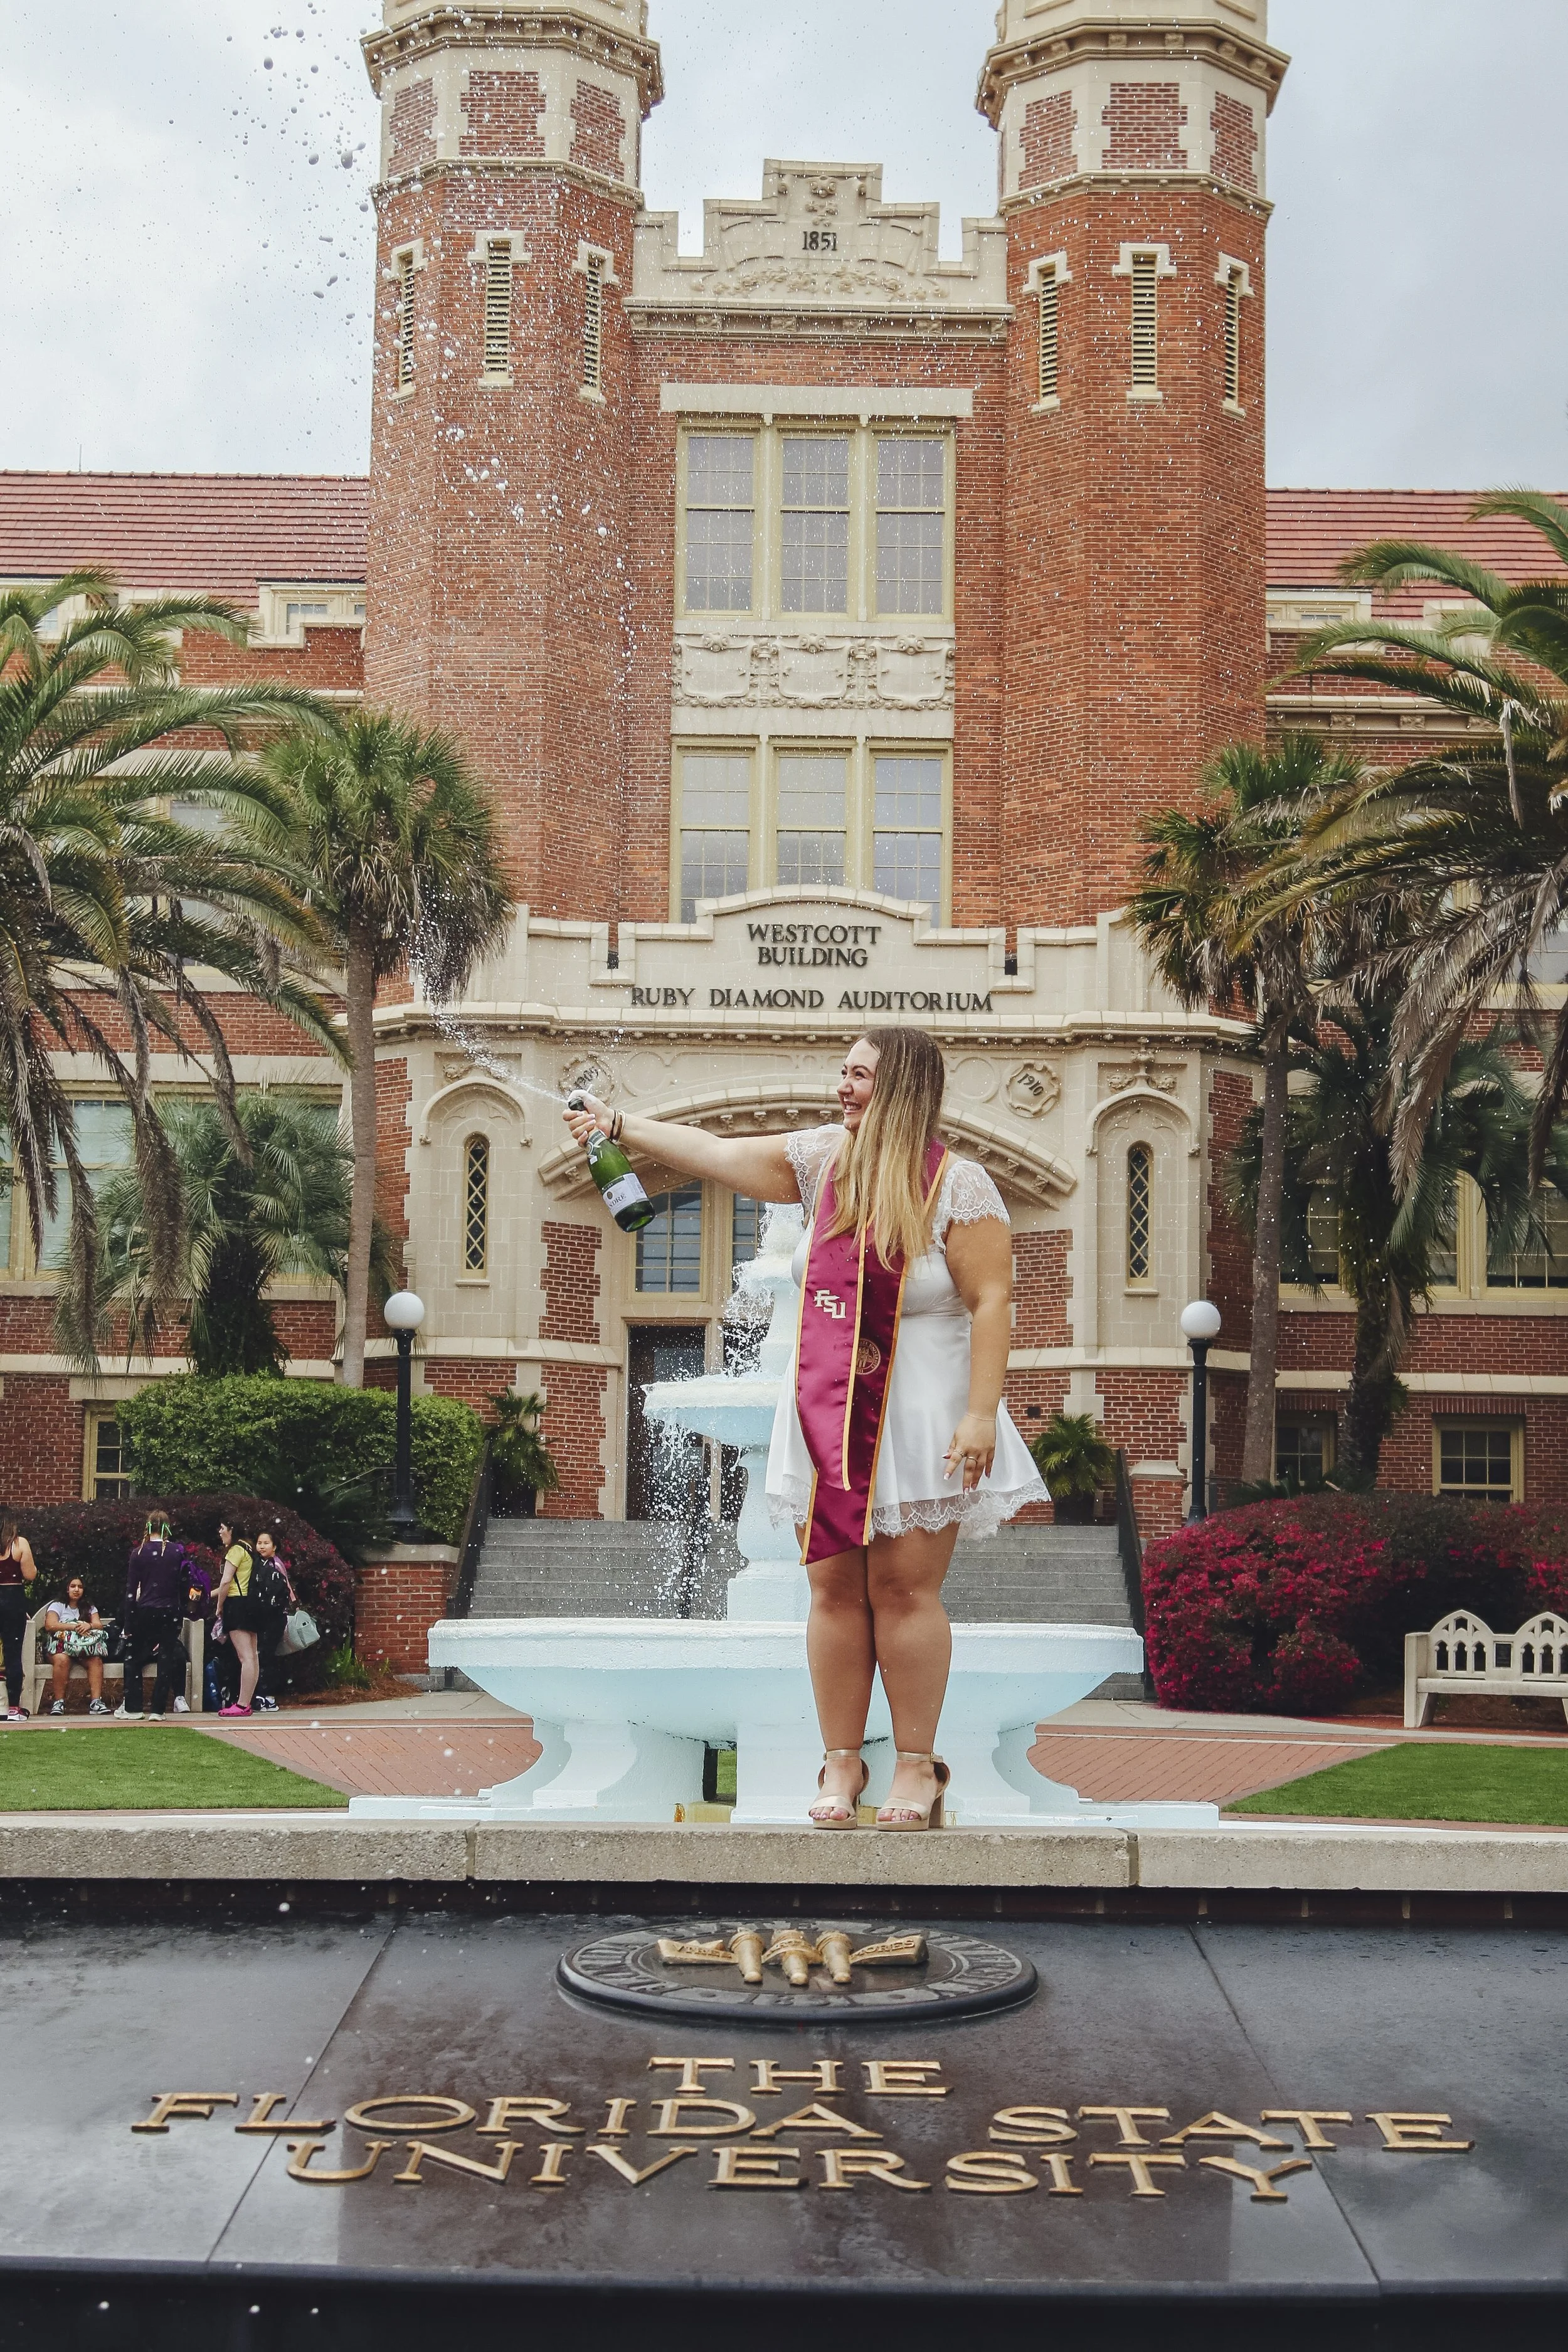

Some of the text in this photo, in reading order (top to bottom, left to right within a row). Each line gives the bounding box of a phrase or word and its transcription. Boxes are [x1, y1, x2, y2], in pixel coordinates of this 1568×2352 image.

[802, 231, 837, 251] 1851
[746, 923, 882, 945] WESTCOTT
[758, 946, 868, 967] BUILDING
[632, 987, 993, 1012] RUBY DIAMOND AUDITORIUM
[1017, 1073, 1044, 1096] 1910
[813, 1289, 847, 1319] FSU
[850, 1939, 916, 1959] MORES
[647, 2057, 953, 2097] THE
[130, 2091, 1475, 2151] FLORIDA STATE
[285, 2140, 1314, 2201] UNIVERSITY
